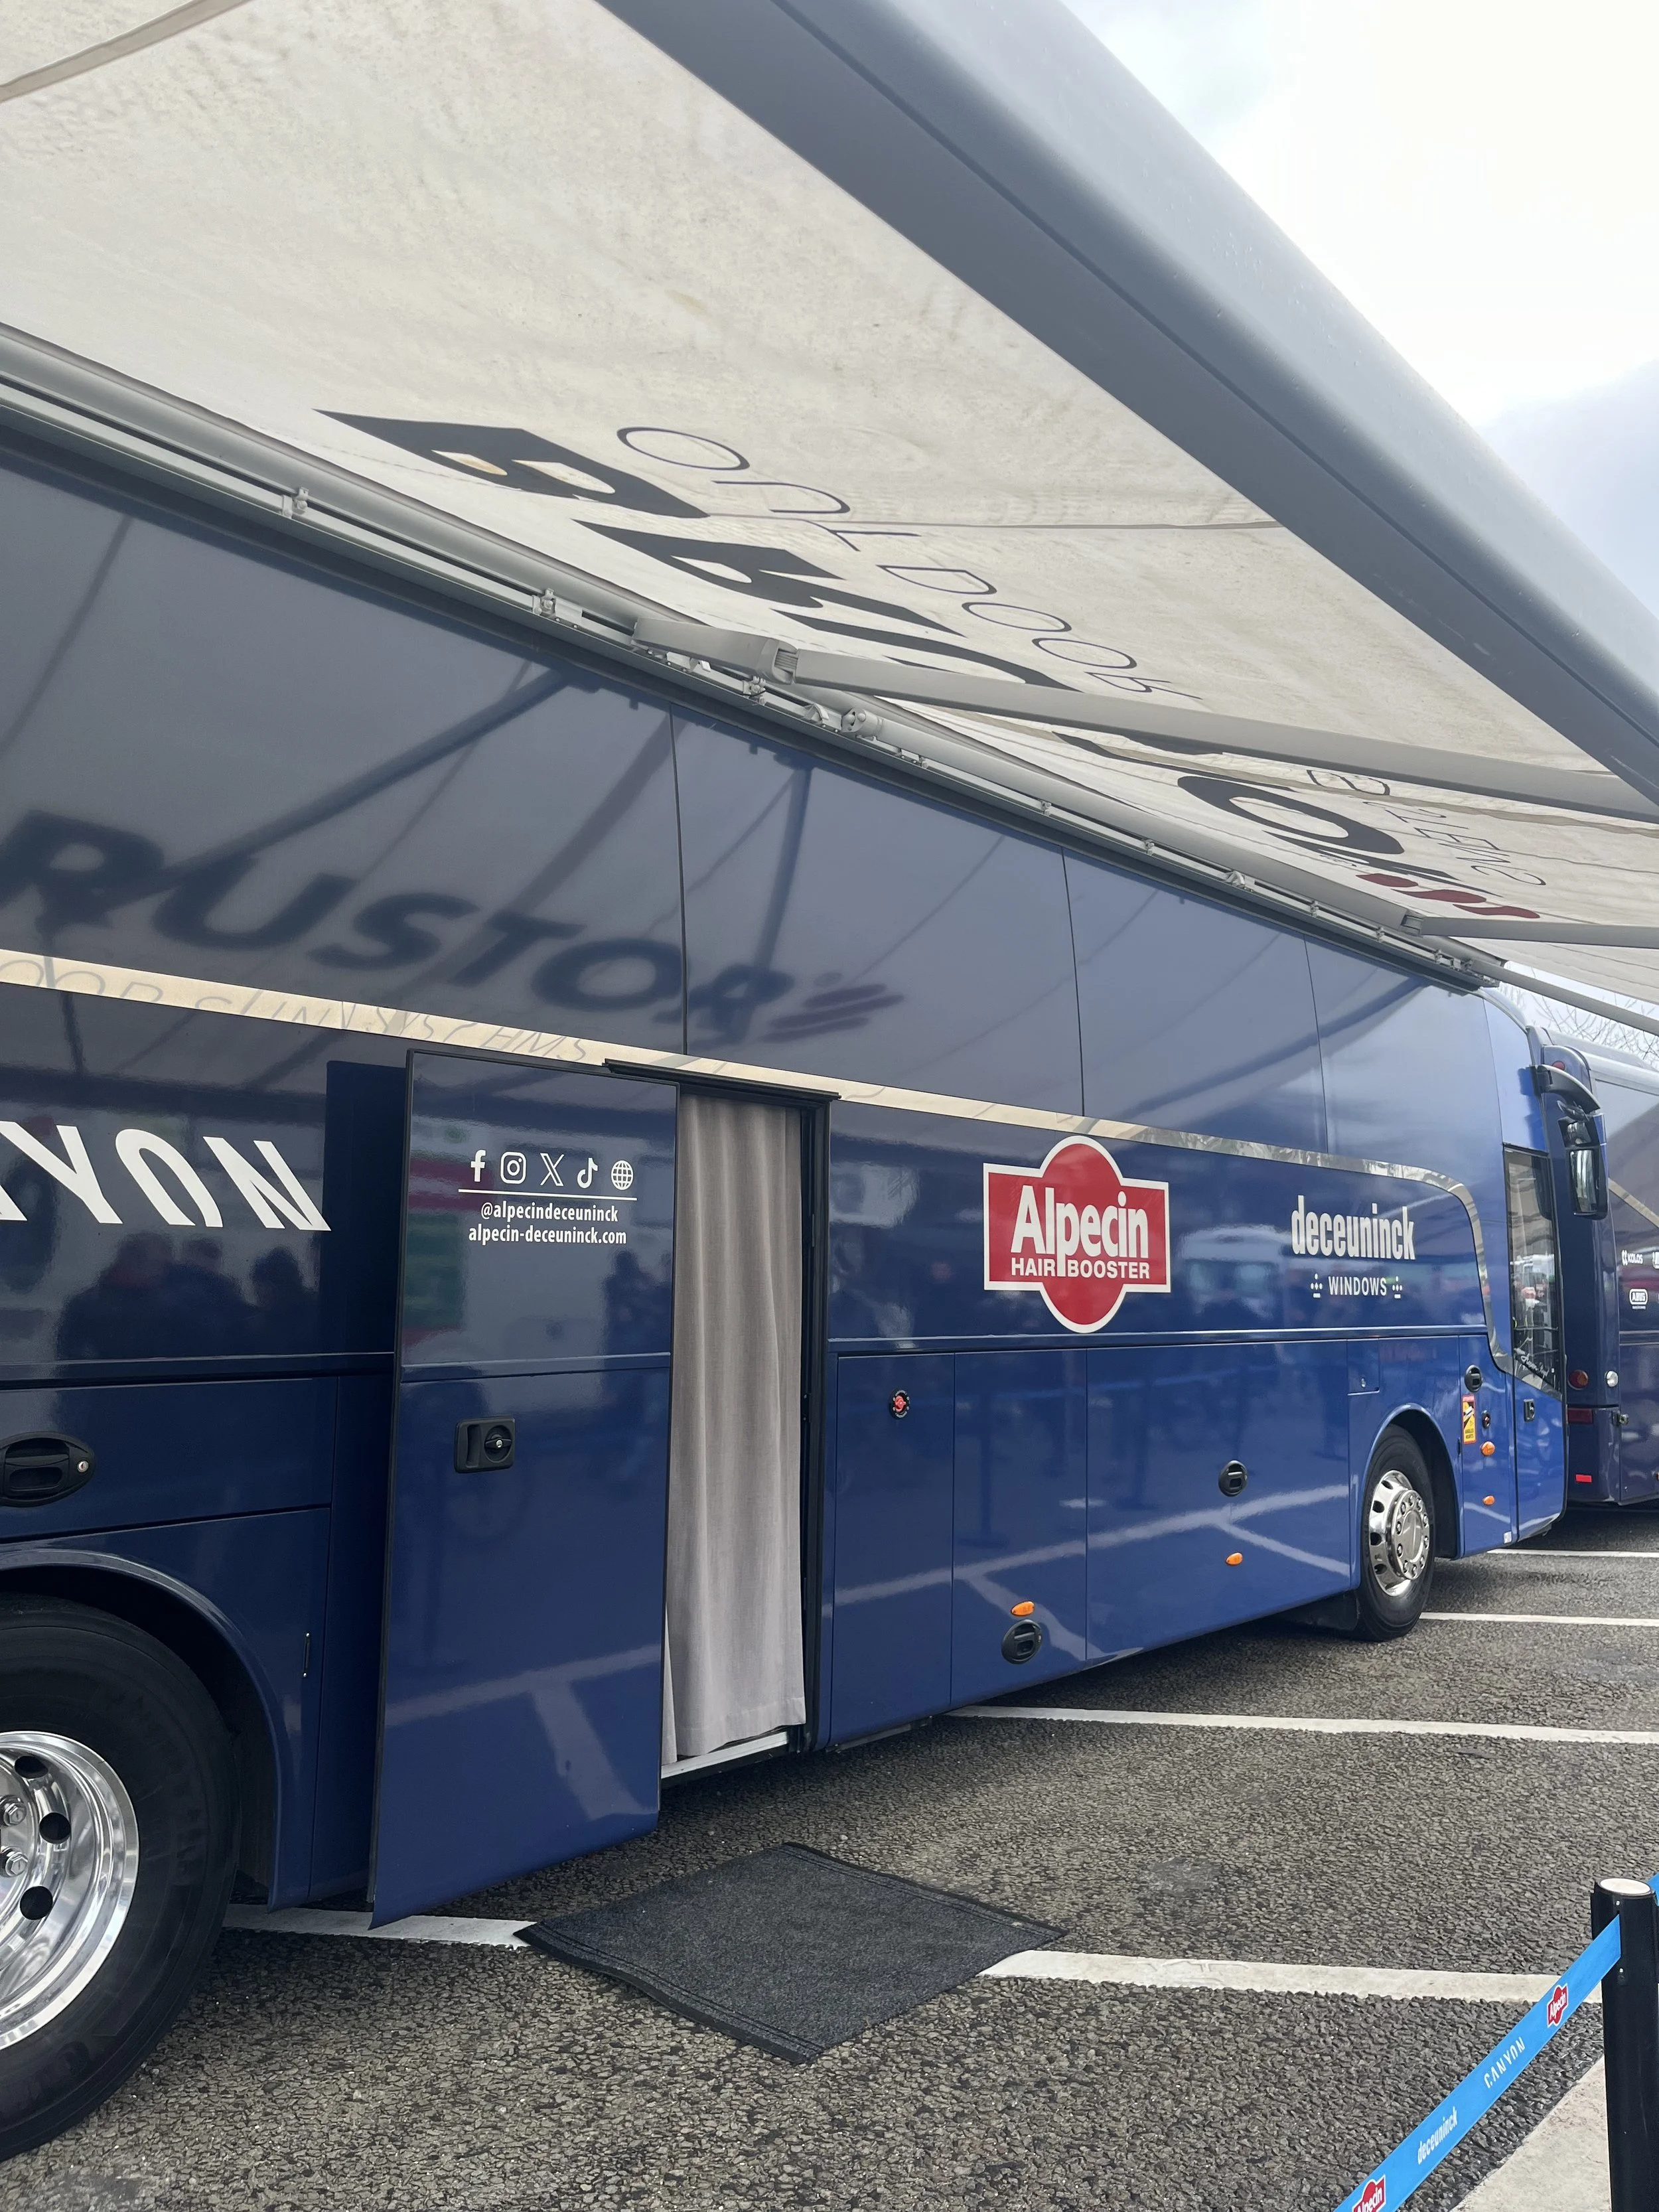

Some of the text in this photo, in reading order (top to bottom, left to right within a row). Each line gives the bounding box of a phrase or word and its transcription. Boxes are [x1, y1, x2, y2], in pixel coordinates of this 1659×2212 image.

[480, 1201, 618, 1222] @alpecindeceuninck
[469, 1223, 627, 1245] alpecin-deceuninck.com
[1010, 1185, 1149, 1277] Alpecin
[1291, 1195, 1415, 1260] deceuninck
[1011, 1257, 1150, 1280] HAIR BOOSTER
[1328, 1276, 1387, 1296] WINDOWS
[1550, 1991, 1566, 2020] Alpecin
[1483, 2036, 1526, 2089] CANYON
[1417, 2105, 1458, 2165] deceuninck
